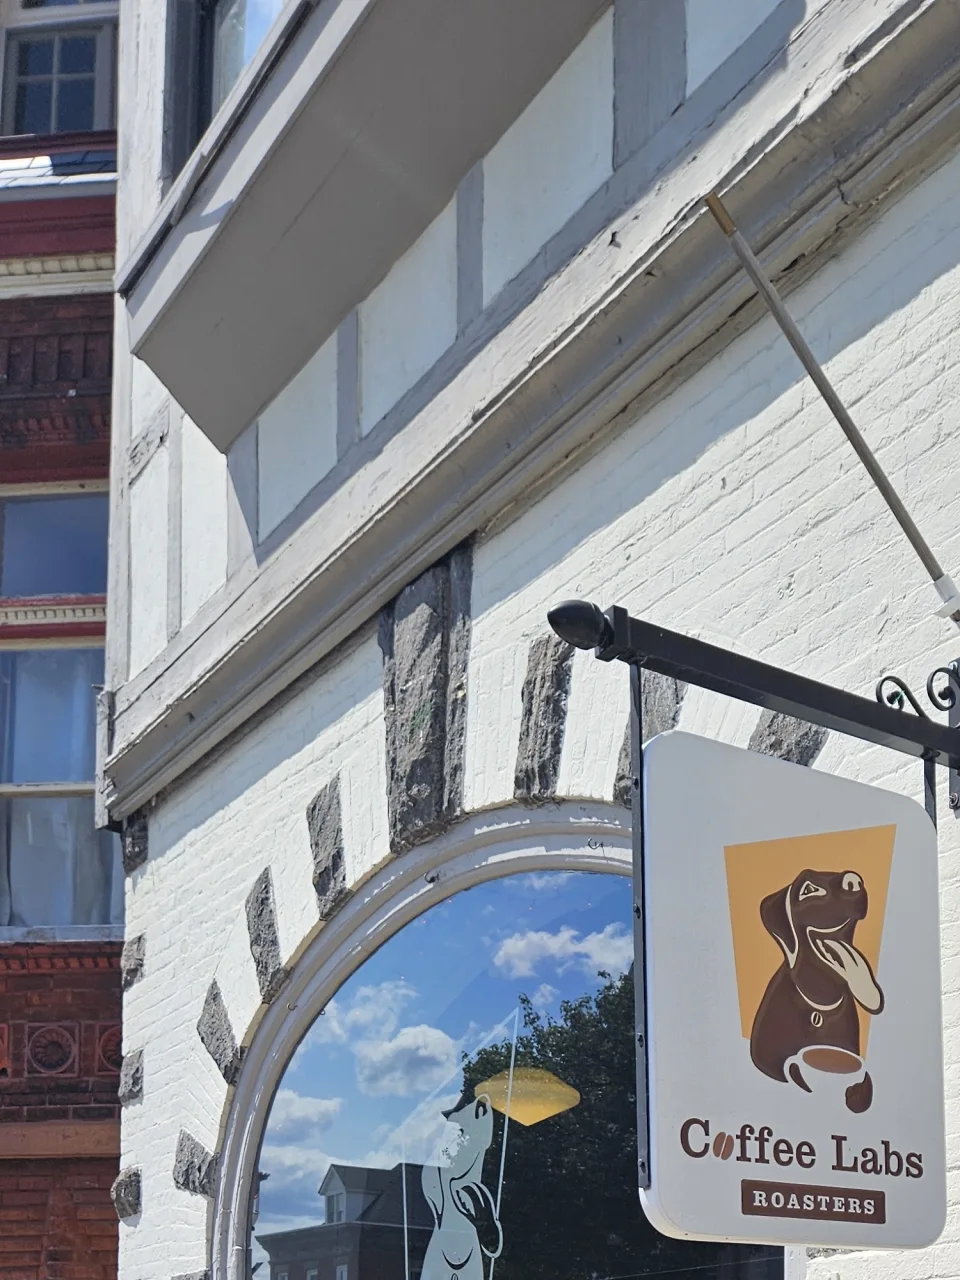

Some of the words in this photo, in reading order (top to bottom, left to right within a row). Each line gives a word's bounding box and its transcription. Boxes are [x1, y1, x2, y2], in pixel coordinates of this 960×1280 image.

[680, 1117, 816, 1169] Coffee
[831, 1134, 924, 1179] Labs
[752, 1190, 876, 1216] ROASTERS
